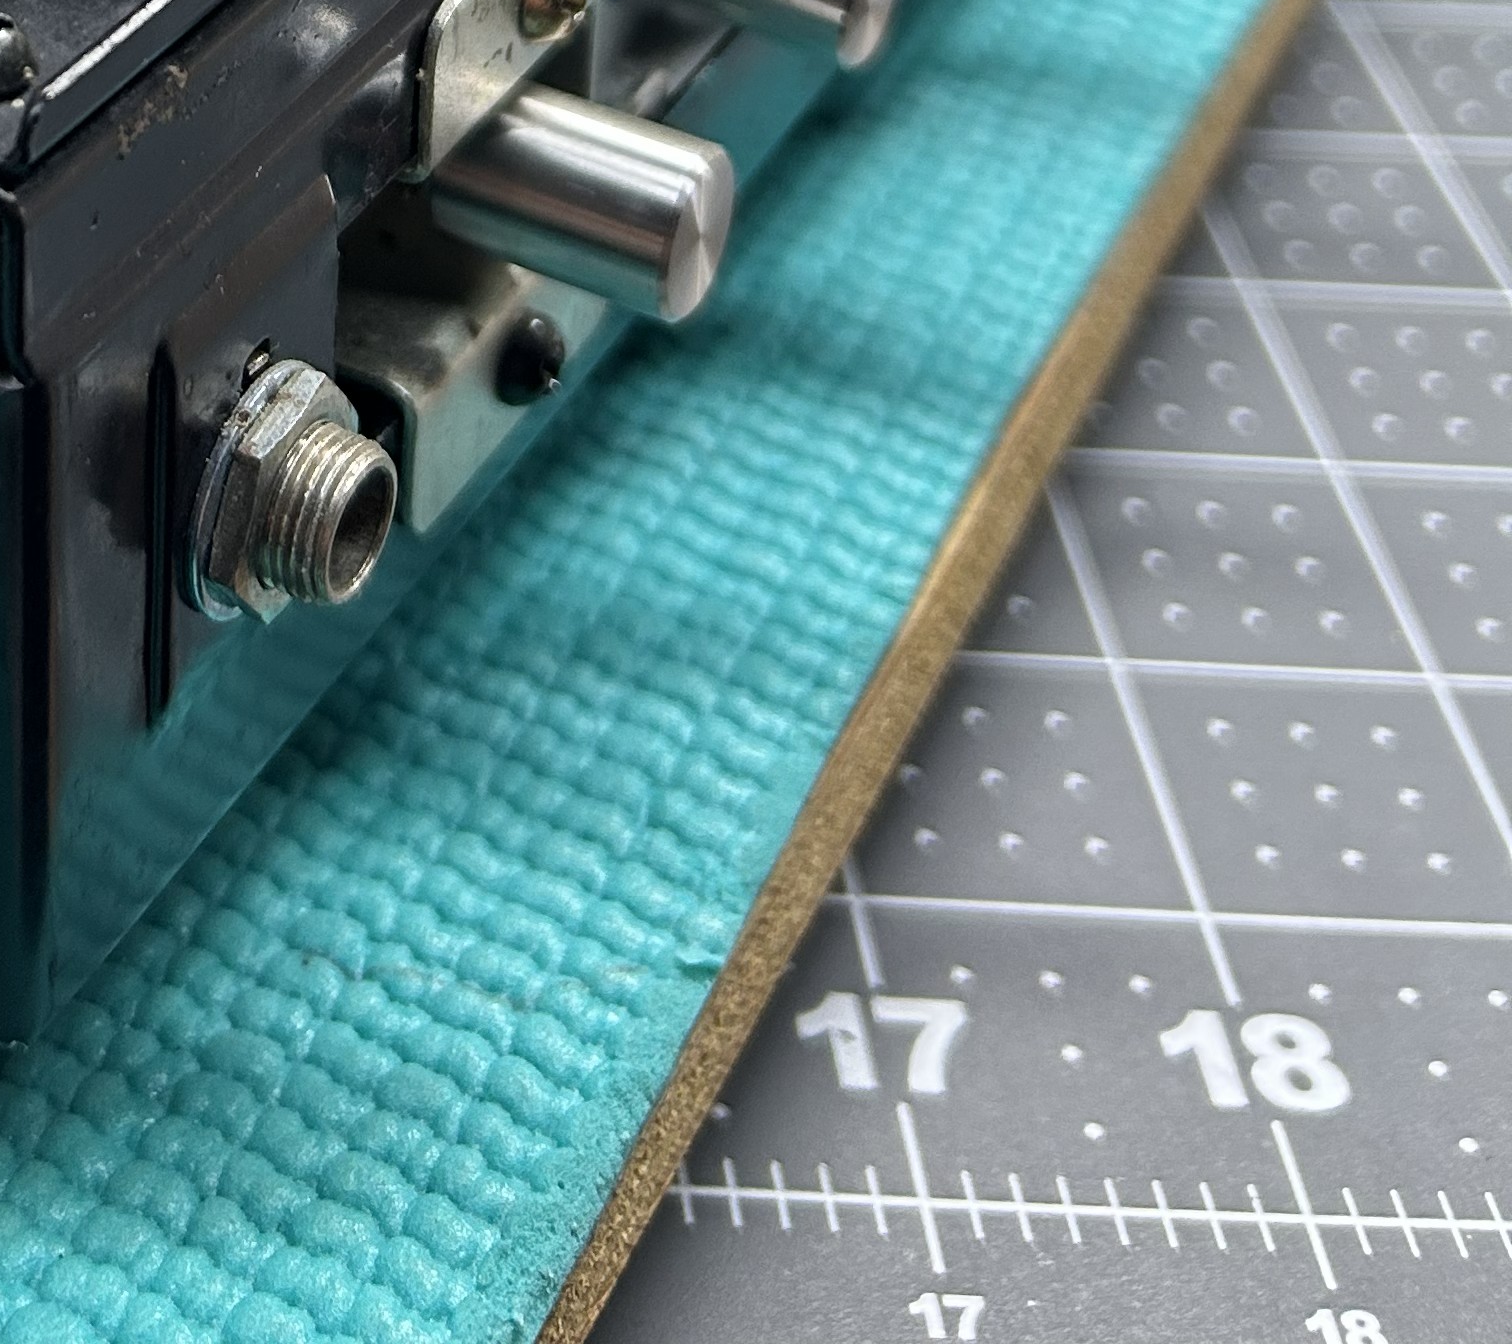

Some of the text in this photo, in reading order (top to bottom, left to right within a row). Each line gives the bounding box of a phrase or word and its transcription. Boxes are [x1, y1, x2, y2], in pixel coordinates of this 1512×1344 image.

[795, 991, 1352, 1112] 17 18
[909, 1292, 1390, 1344] 17 18
